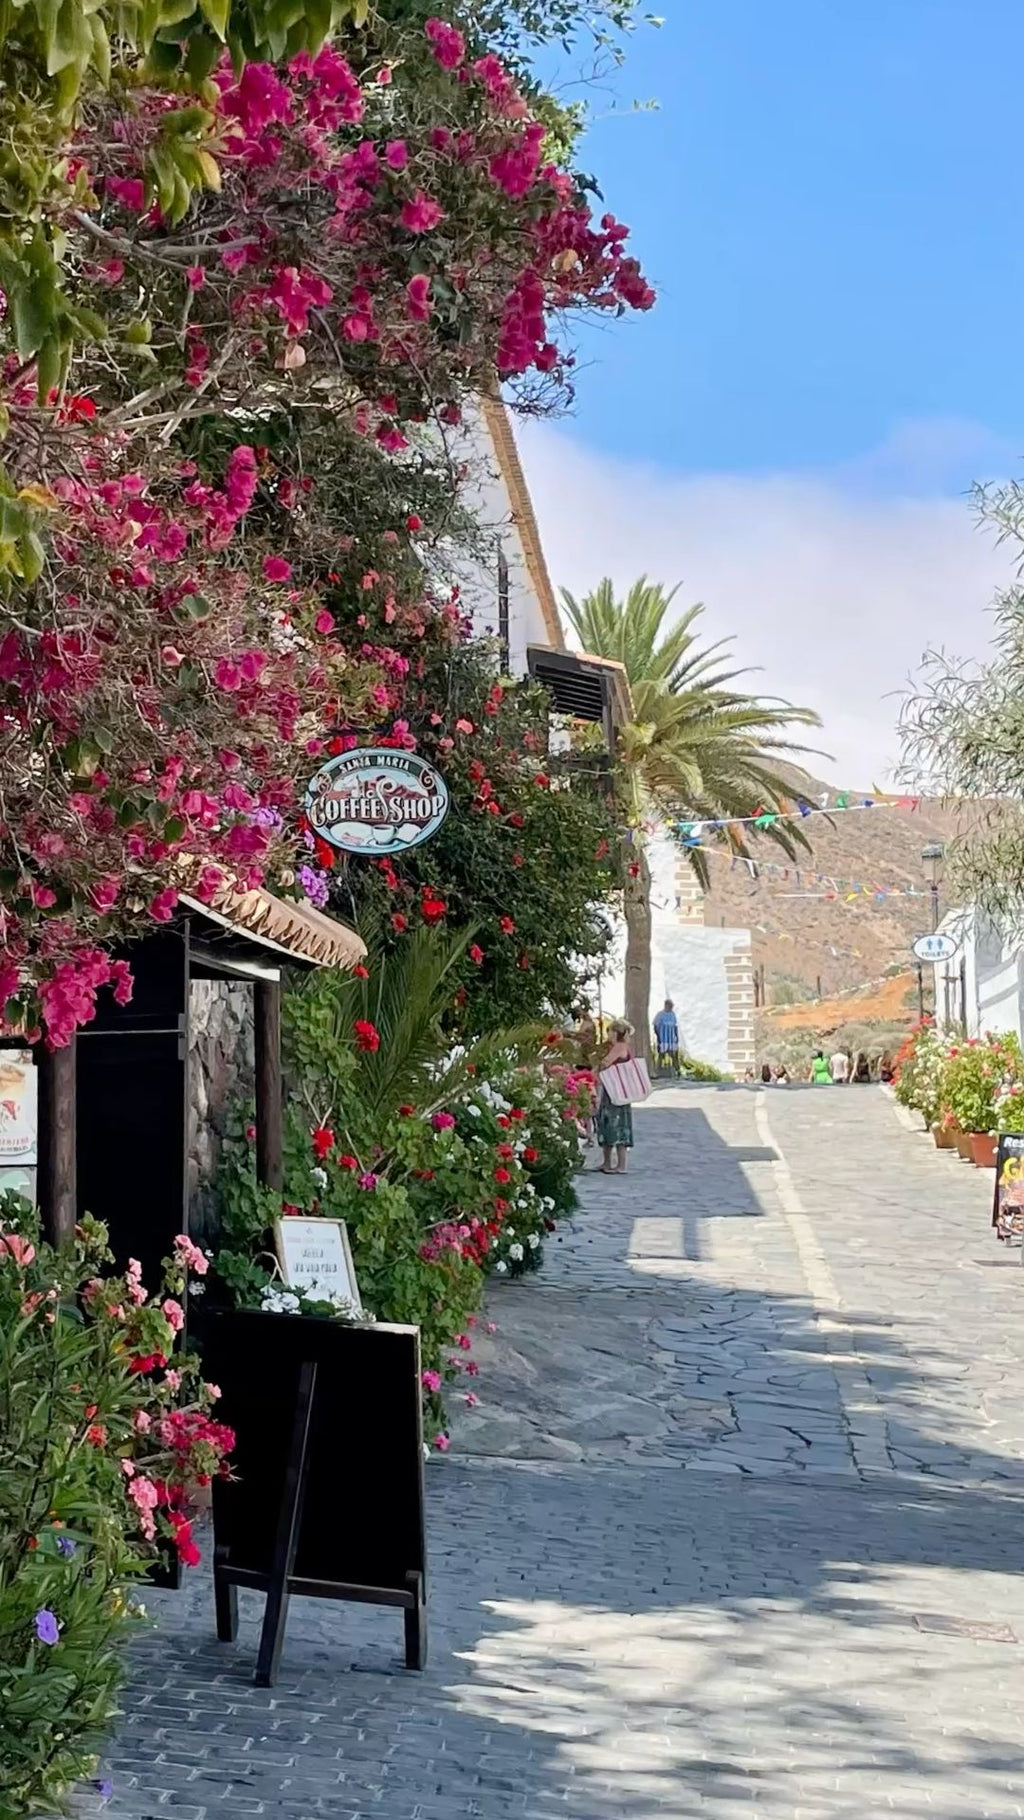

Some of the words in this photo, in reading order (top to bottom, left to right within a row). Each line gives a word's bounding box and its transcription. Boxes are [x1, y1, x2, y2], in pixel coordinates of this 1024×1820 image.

[338, 757, 371, 773] SANTA
[376, 756, 410, 771] MARIA
[310, 796, 382, 827] COFFEE
[388, 795, 446, 823] SHOP
